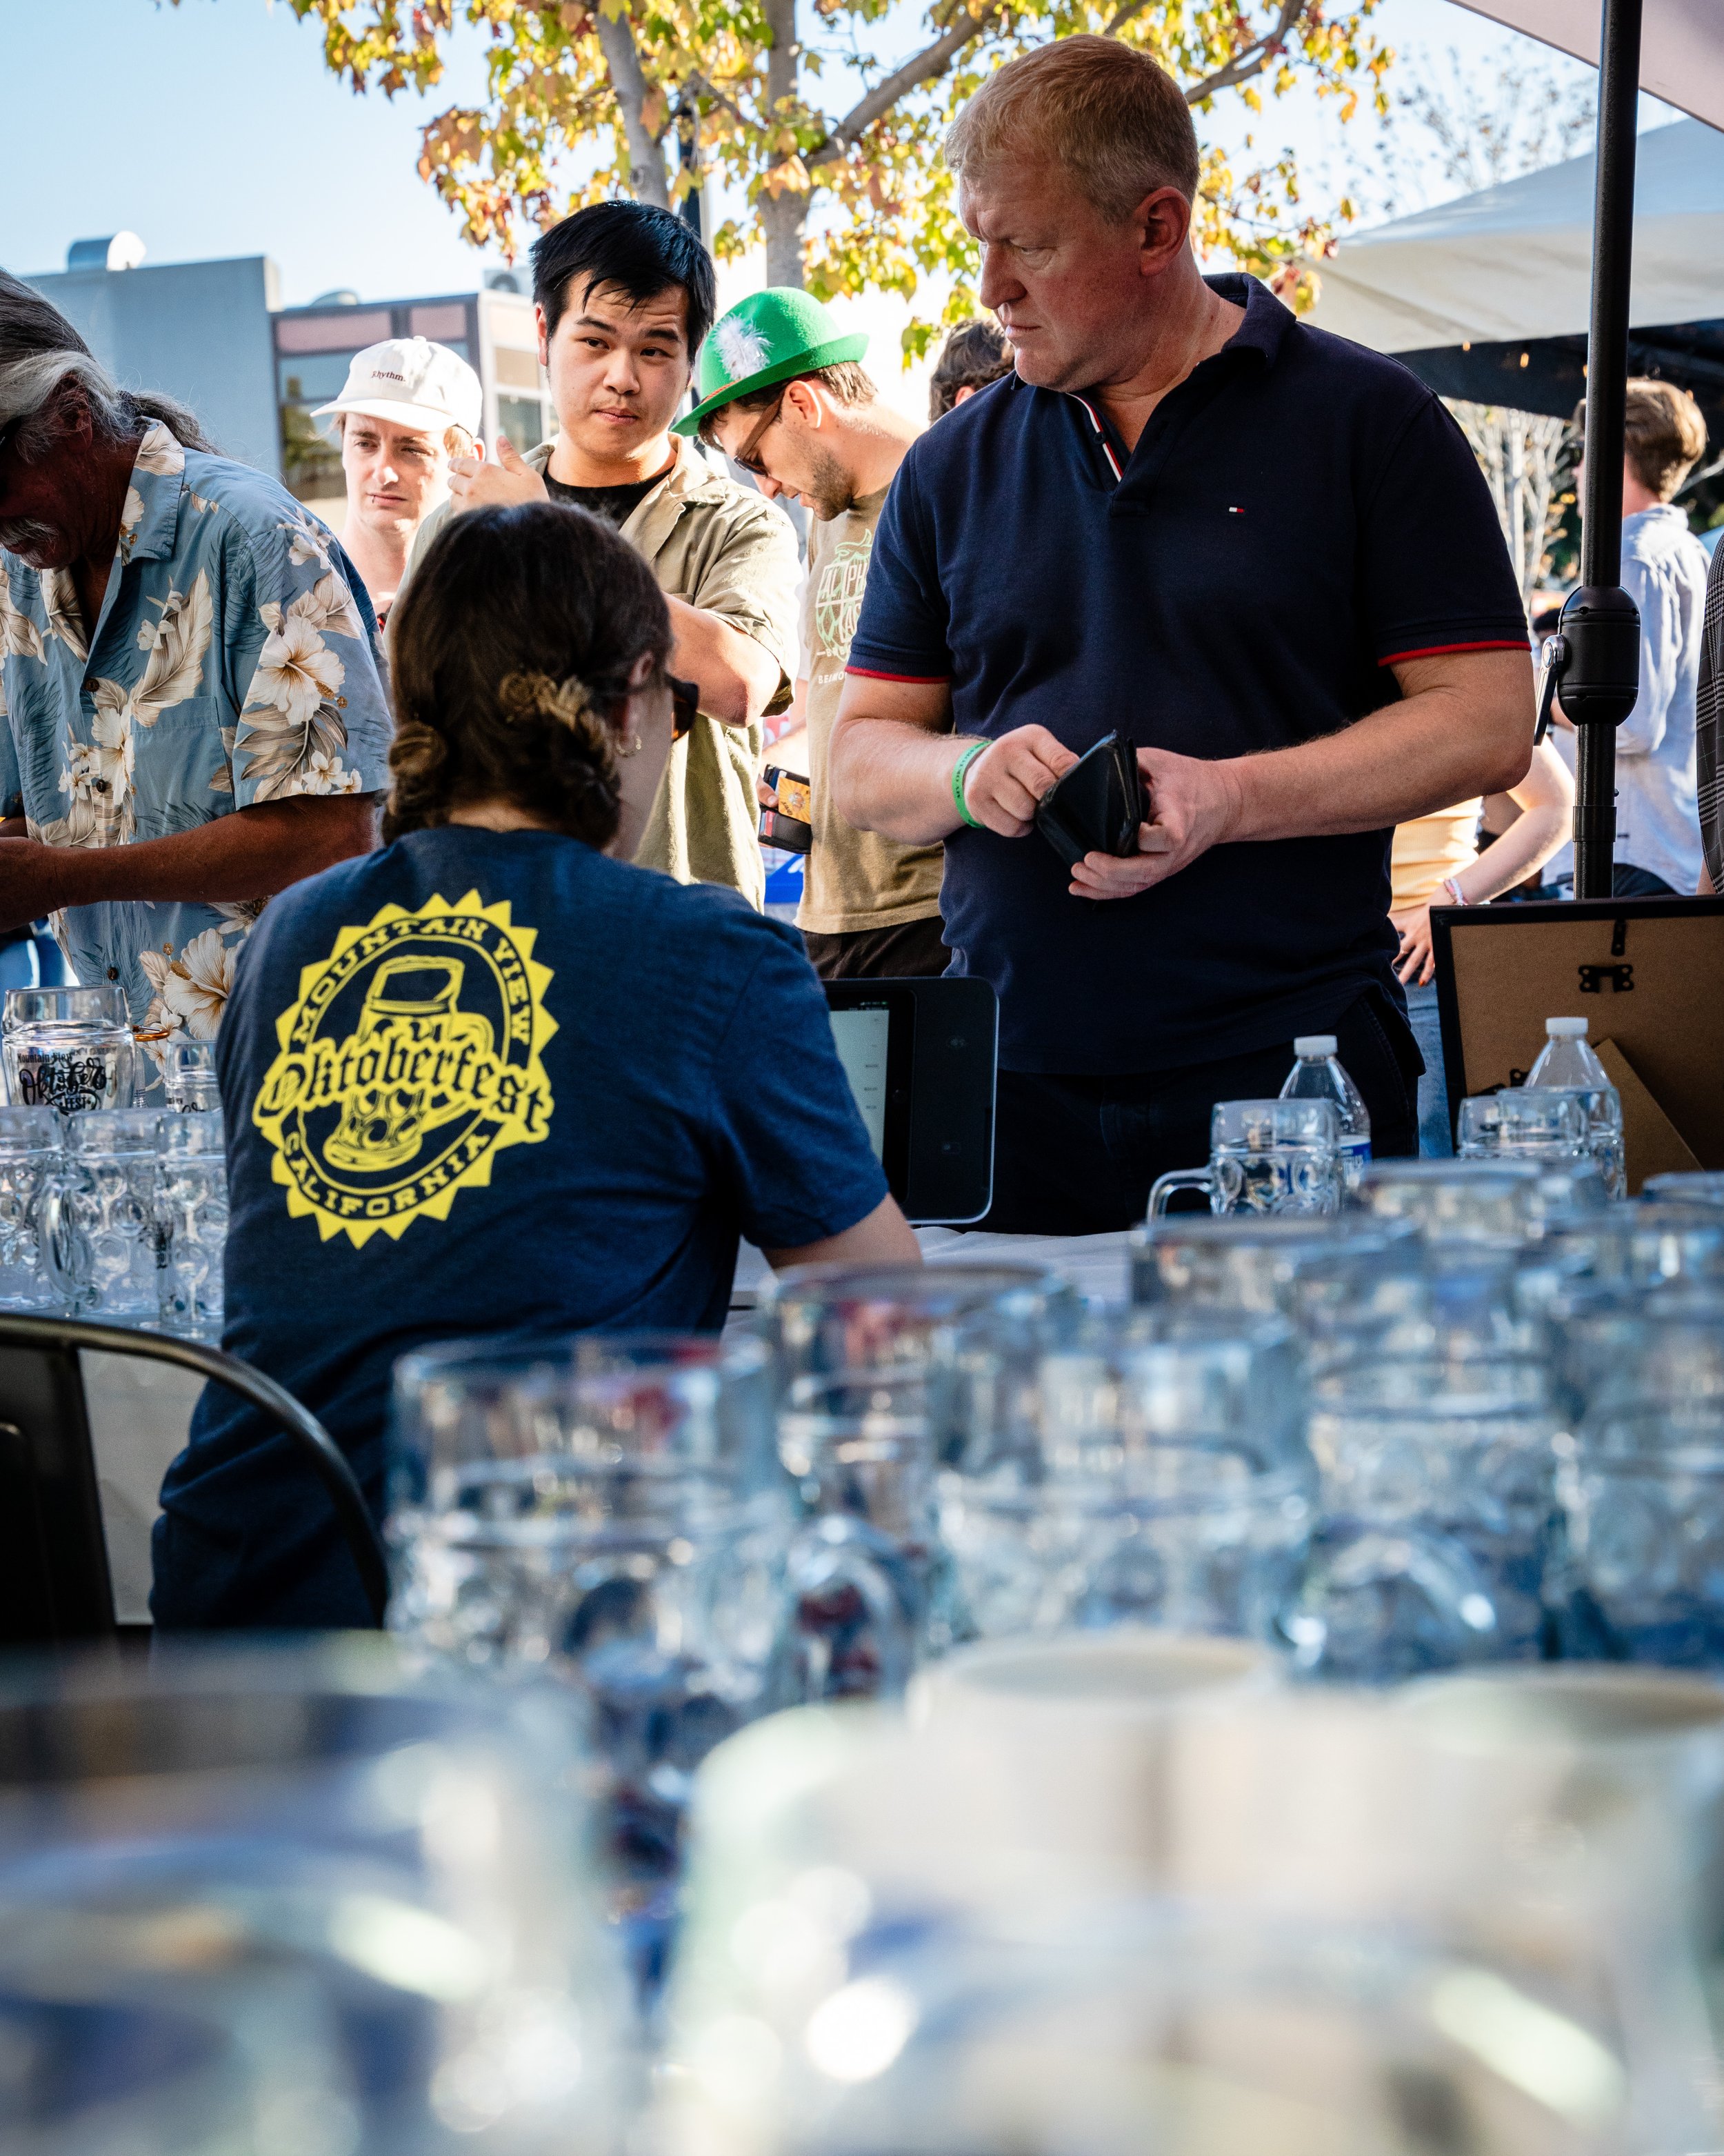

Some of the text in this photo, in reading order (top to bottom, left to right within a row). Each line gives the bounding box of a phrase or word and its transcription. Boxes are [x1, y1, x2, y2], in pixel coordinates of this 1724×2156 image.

[372, 370, 405, 381] Rhythm.
[818, 670, 848, 684] BELMO
[292, 917, 530, 1046] MOUNTAIN VIEW
[257, 1037, 549, 1133] Oktoberfest
[284, 1131, 491, 1217] CALIFORNIA
